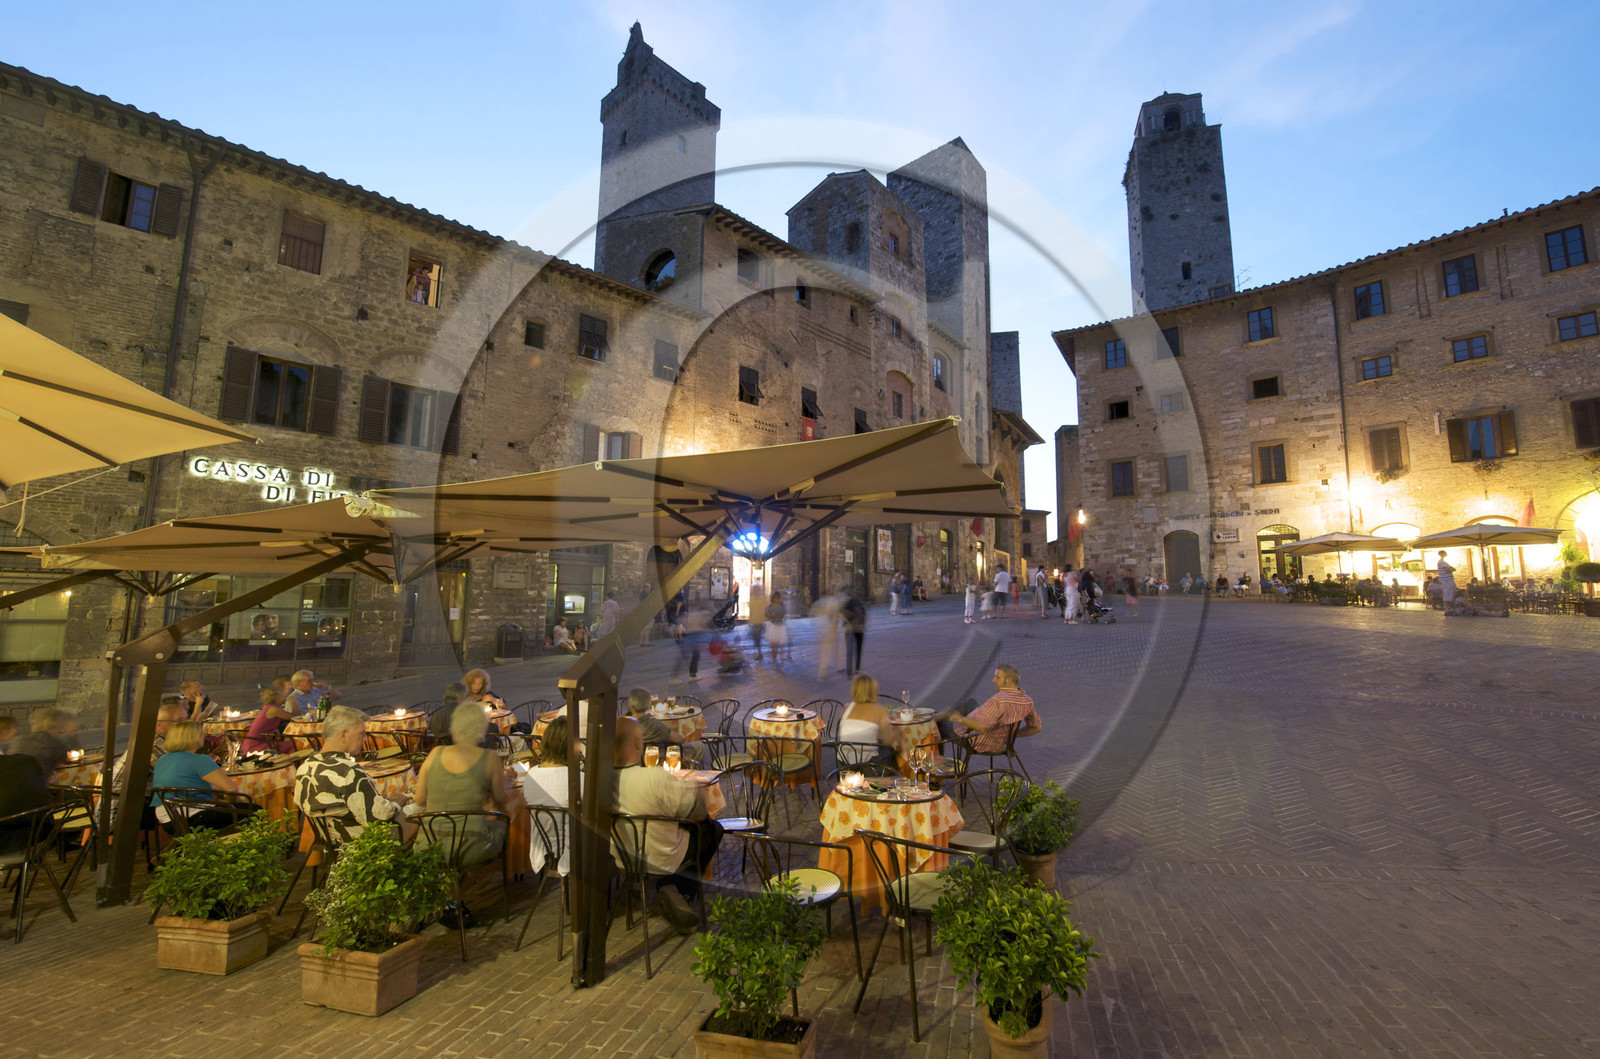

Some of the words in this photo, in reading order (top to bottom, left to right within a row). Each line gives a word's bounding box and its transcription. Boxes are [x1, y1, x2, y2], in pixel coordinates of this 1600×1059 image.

[194, 458, 287, 482] CASSA
[307, 471, 331, 487] DI
[266, 486, 291, 502] DI
